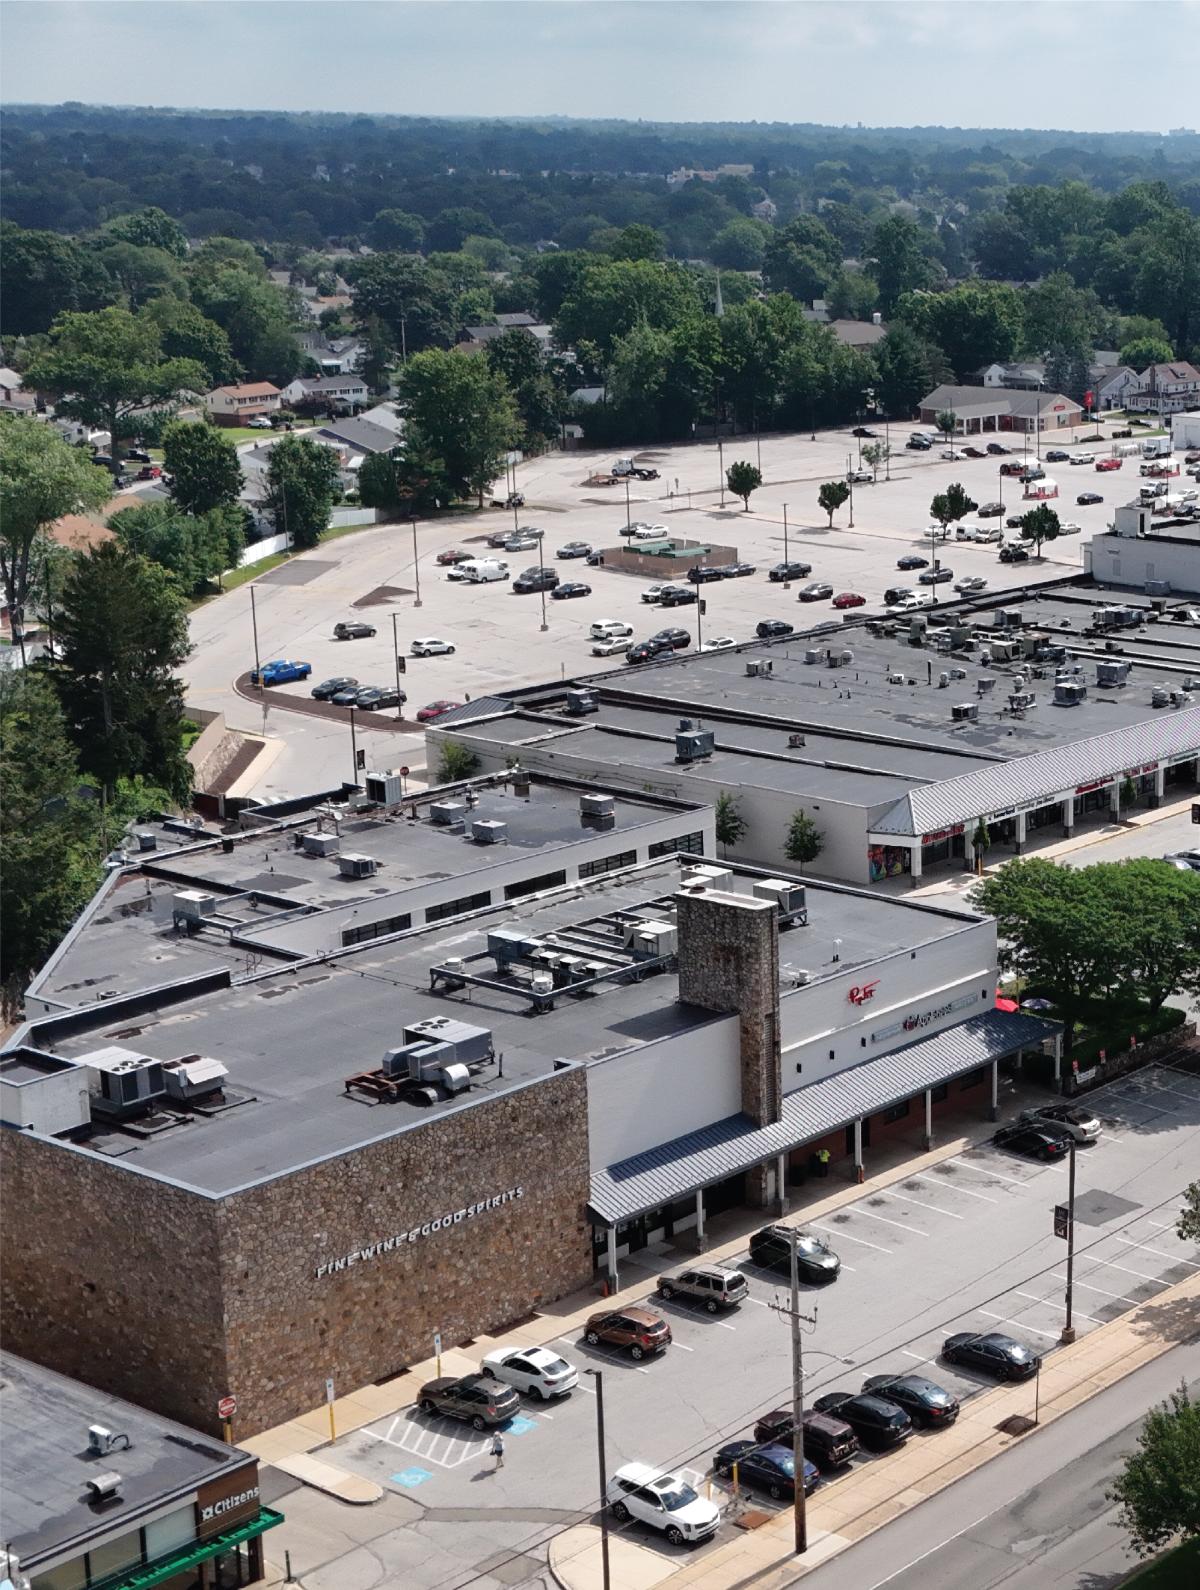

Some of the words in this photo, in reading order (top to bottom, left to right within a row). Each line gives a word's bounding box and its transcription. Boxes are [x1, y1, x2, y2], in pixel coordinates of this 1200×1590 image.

[316, 1256, 355, 1279] FINE
[361, 1236, 403, 1261] WINE
[421, 1212, 462, 1236] GOOD
[466, 1186, 524, 1218] SPIRITS
[214, 1486, 260, 1514] Citizens
